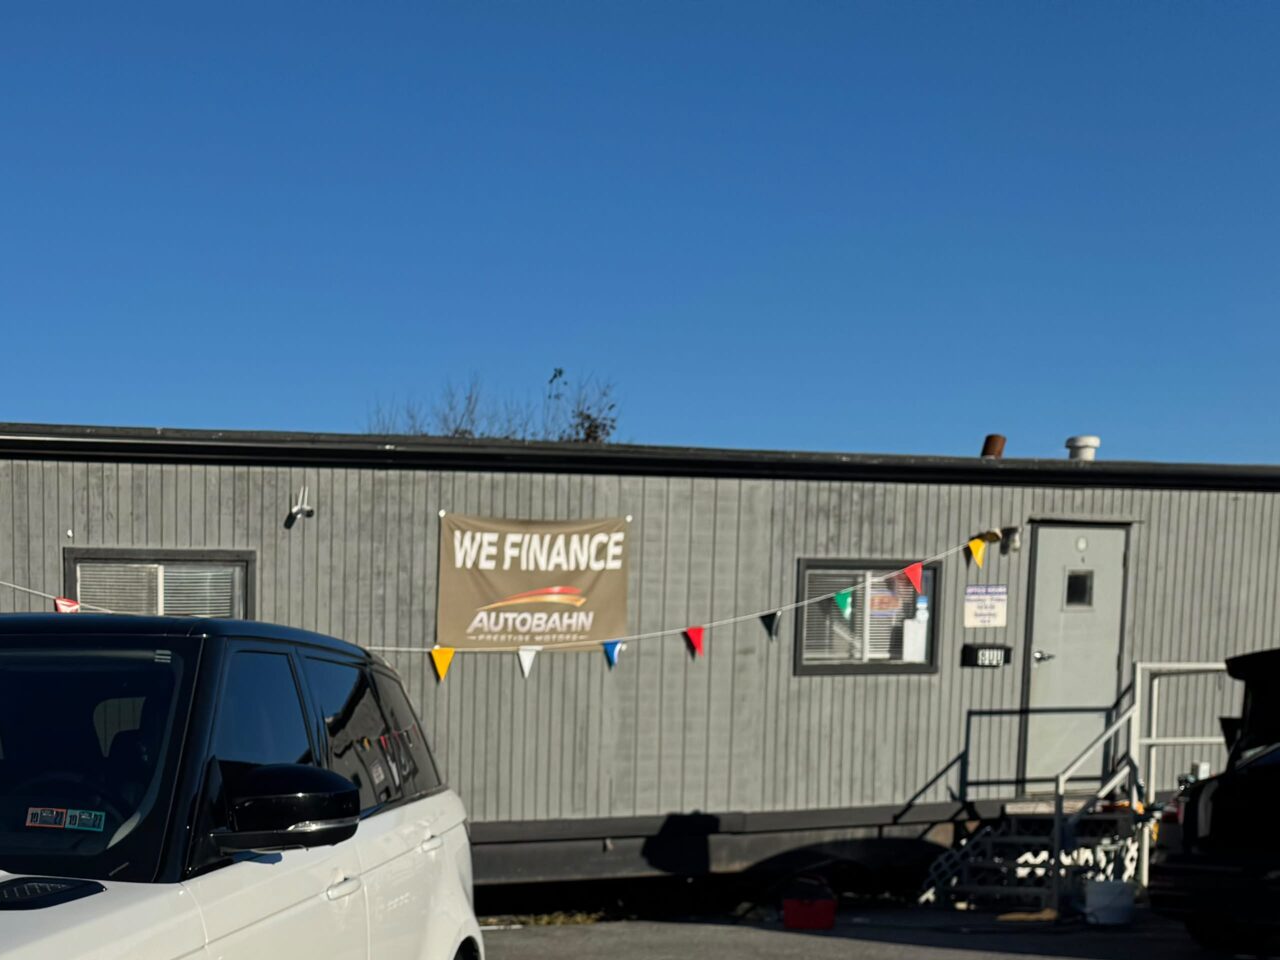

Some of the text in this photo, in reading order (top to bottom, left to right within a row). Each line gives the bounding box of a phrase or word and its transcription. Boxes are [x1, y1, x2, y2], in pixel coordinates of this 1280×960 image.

[453, 530, 625, 571] WE FINANCE
[466, 611, 595, 634] AUTOBAHN
